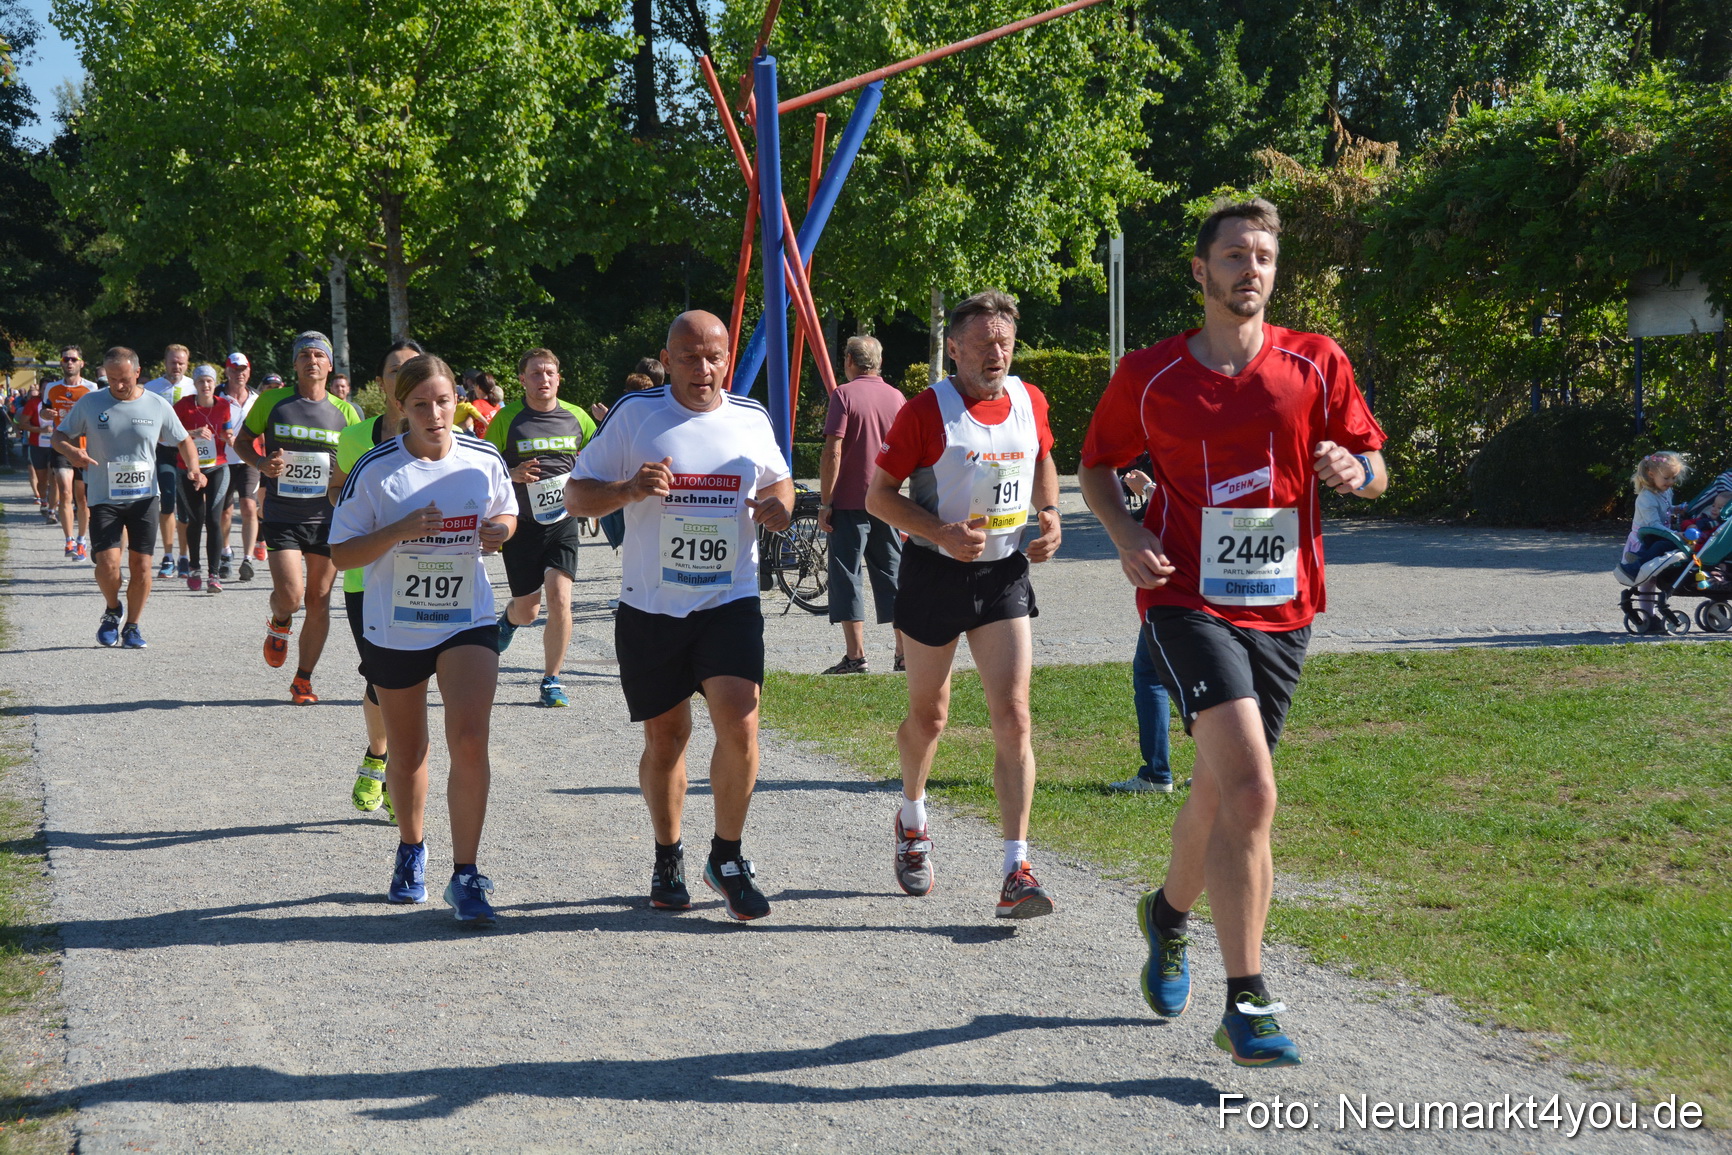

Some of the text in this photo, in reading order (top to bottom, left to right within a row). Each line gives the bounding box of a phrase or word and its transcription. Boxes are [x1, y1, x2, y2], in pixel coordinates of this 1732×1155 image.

[274, 422, 341, 445] BOCK
[516, 436, 577, 453] BOCK
[982, 451, 1024, 461] KLEBI
[285, 464, 321, 479] 2525
[115, 472, 146, 484] 2266
[1228, 478, 1254, 494] DEHN
[537, 487, 565, 508] 252
[993, 480, 1019, 505] 191
[664, 493, 735, 505] Bachmaier
[683, 523, 718, 533] BOCK
[992, 517, 1016, 527] Rainer
[1233, 517, 1274, 528] BOCK
[671, 537, 727, 561] 2196
[1217, 535, 1285, 564] 2446
[418, 561, 453, 570] BOCK
[1246, 567, 1273, 575] Neumarkt
[677, 573, 717, 584] Reinhard
[405, 574, 463, 598] 2197
[1225, 581, 1276, 594] Christian
[416, 611, 450, 621] Nadine
